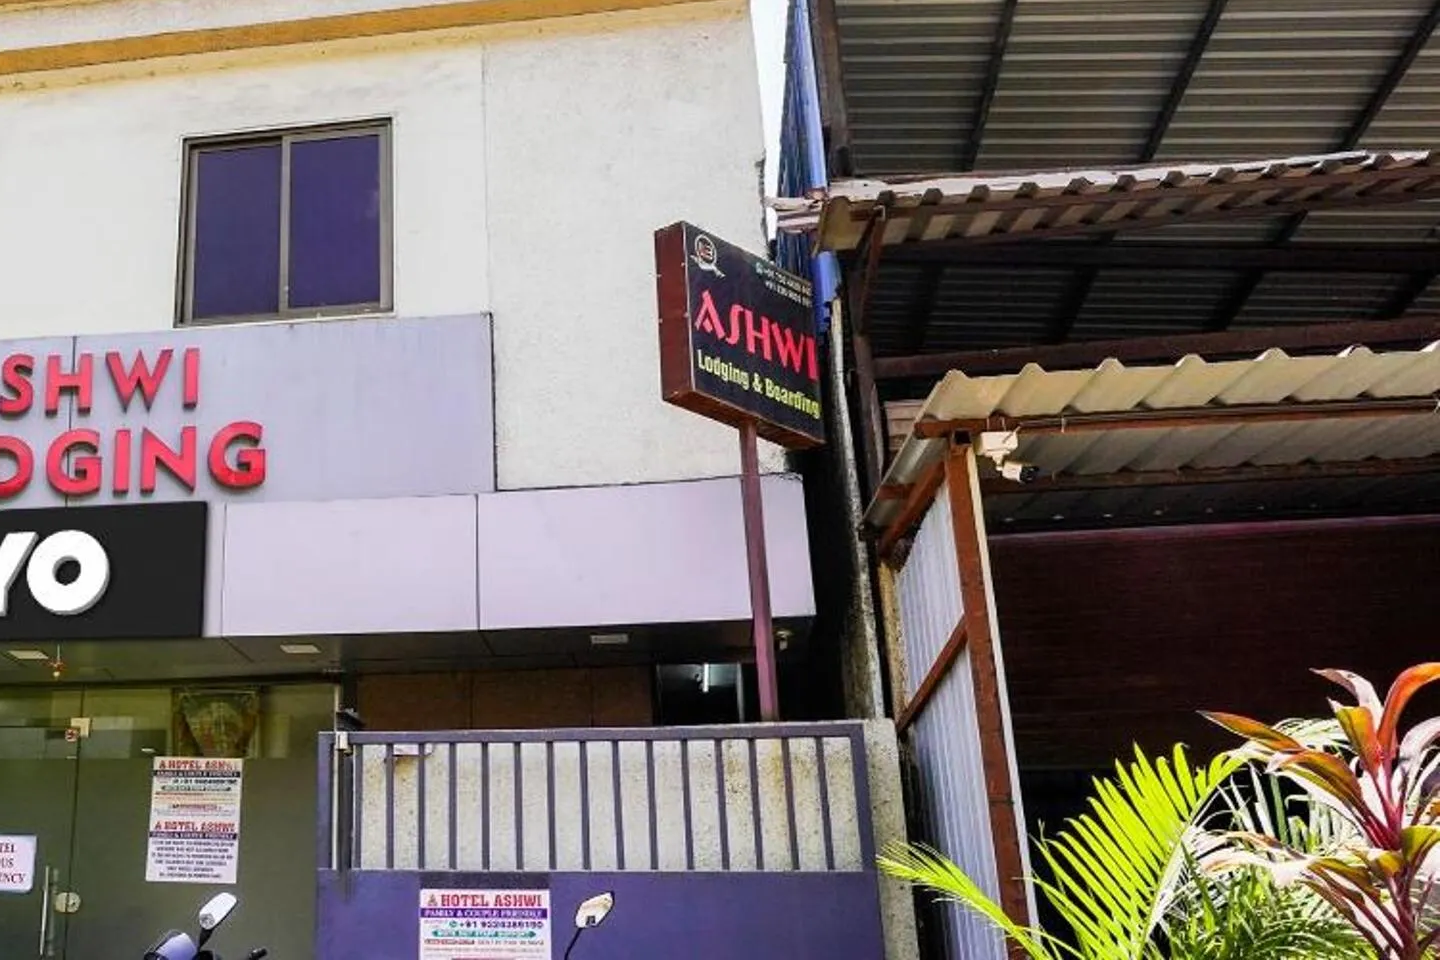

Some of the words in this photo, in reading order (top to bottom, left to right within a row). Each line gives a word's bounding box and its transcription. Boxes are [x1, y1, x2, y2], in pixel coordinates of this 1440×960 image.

[695, 290, 820, 380] ASHWI
[698, 349, 750, 391] Lodging
[751, 376, 763, 394] &
[765, 378, 821, 419] Boarding
[441, 894, 489, 907] HOTEL
[494, 894, 542, 907] ASHWI
